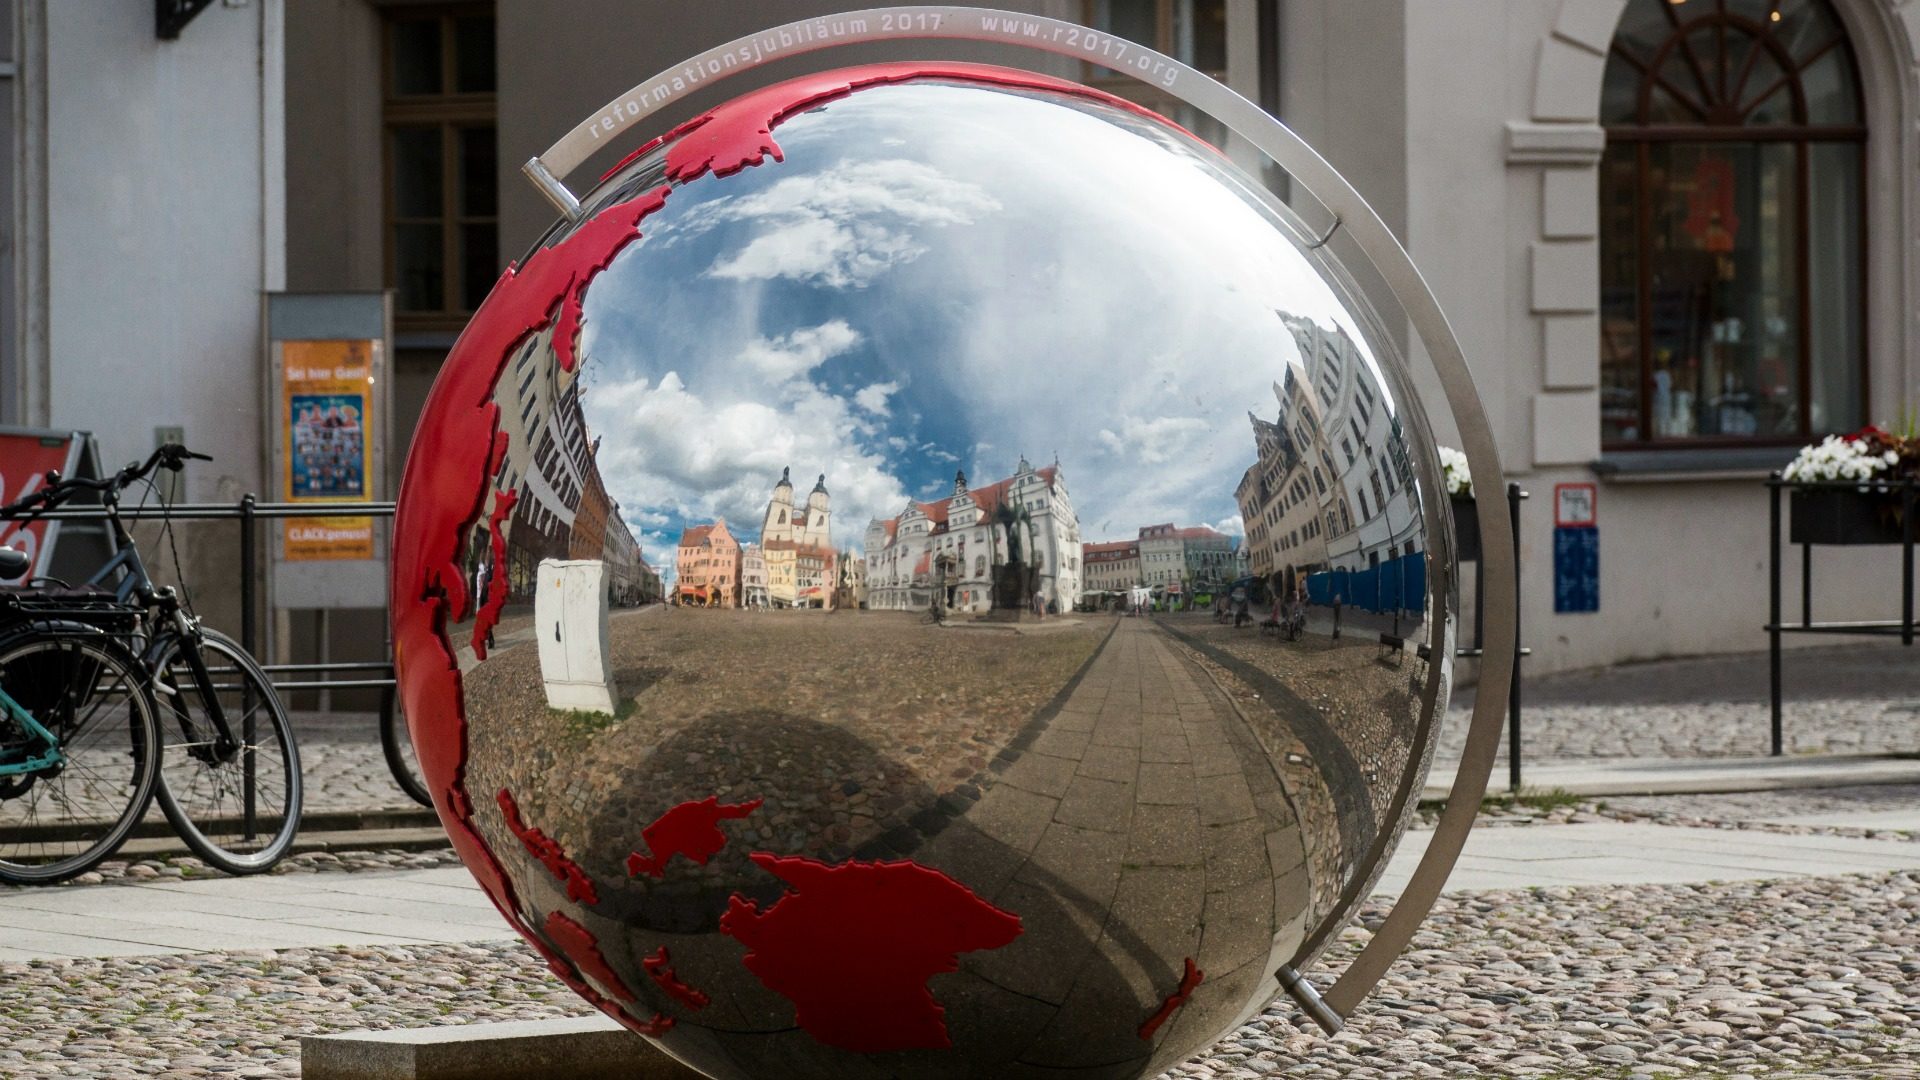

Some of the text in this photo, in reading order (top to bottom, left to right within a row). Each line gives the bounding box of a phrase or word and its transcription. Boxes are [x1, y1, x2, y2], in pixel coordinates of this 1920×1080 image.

[588, 13, 1181, 139] reformationsjubiläum 2017 www.r2017.org
